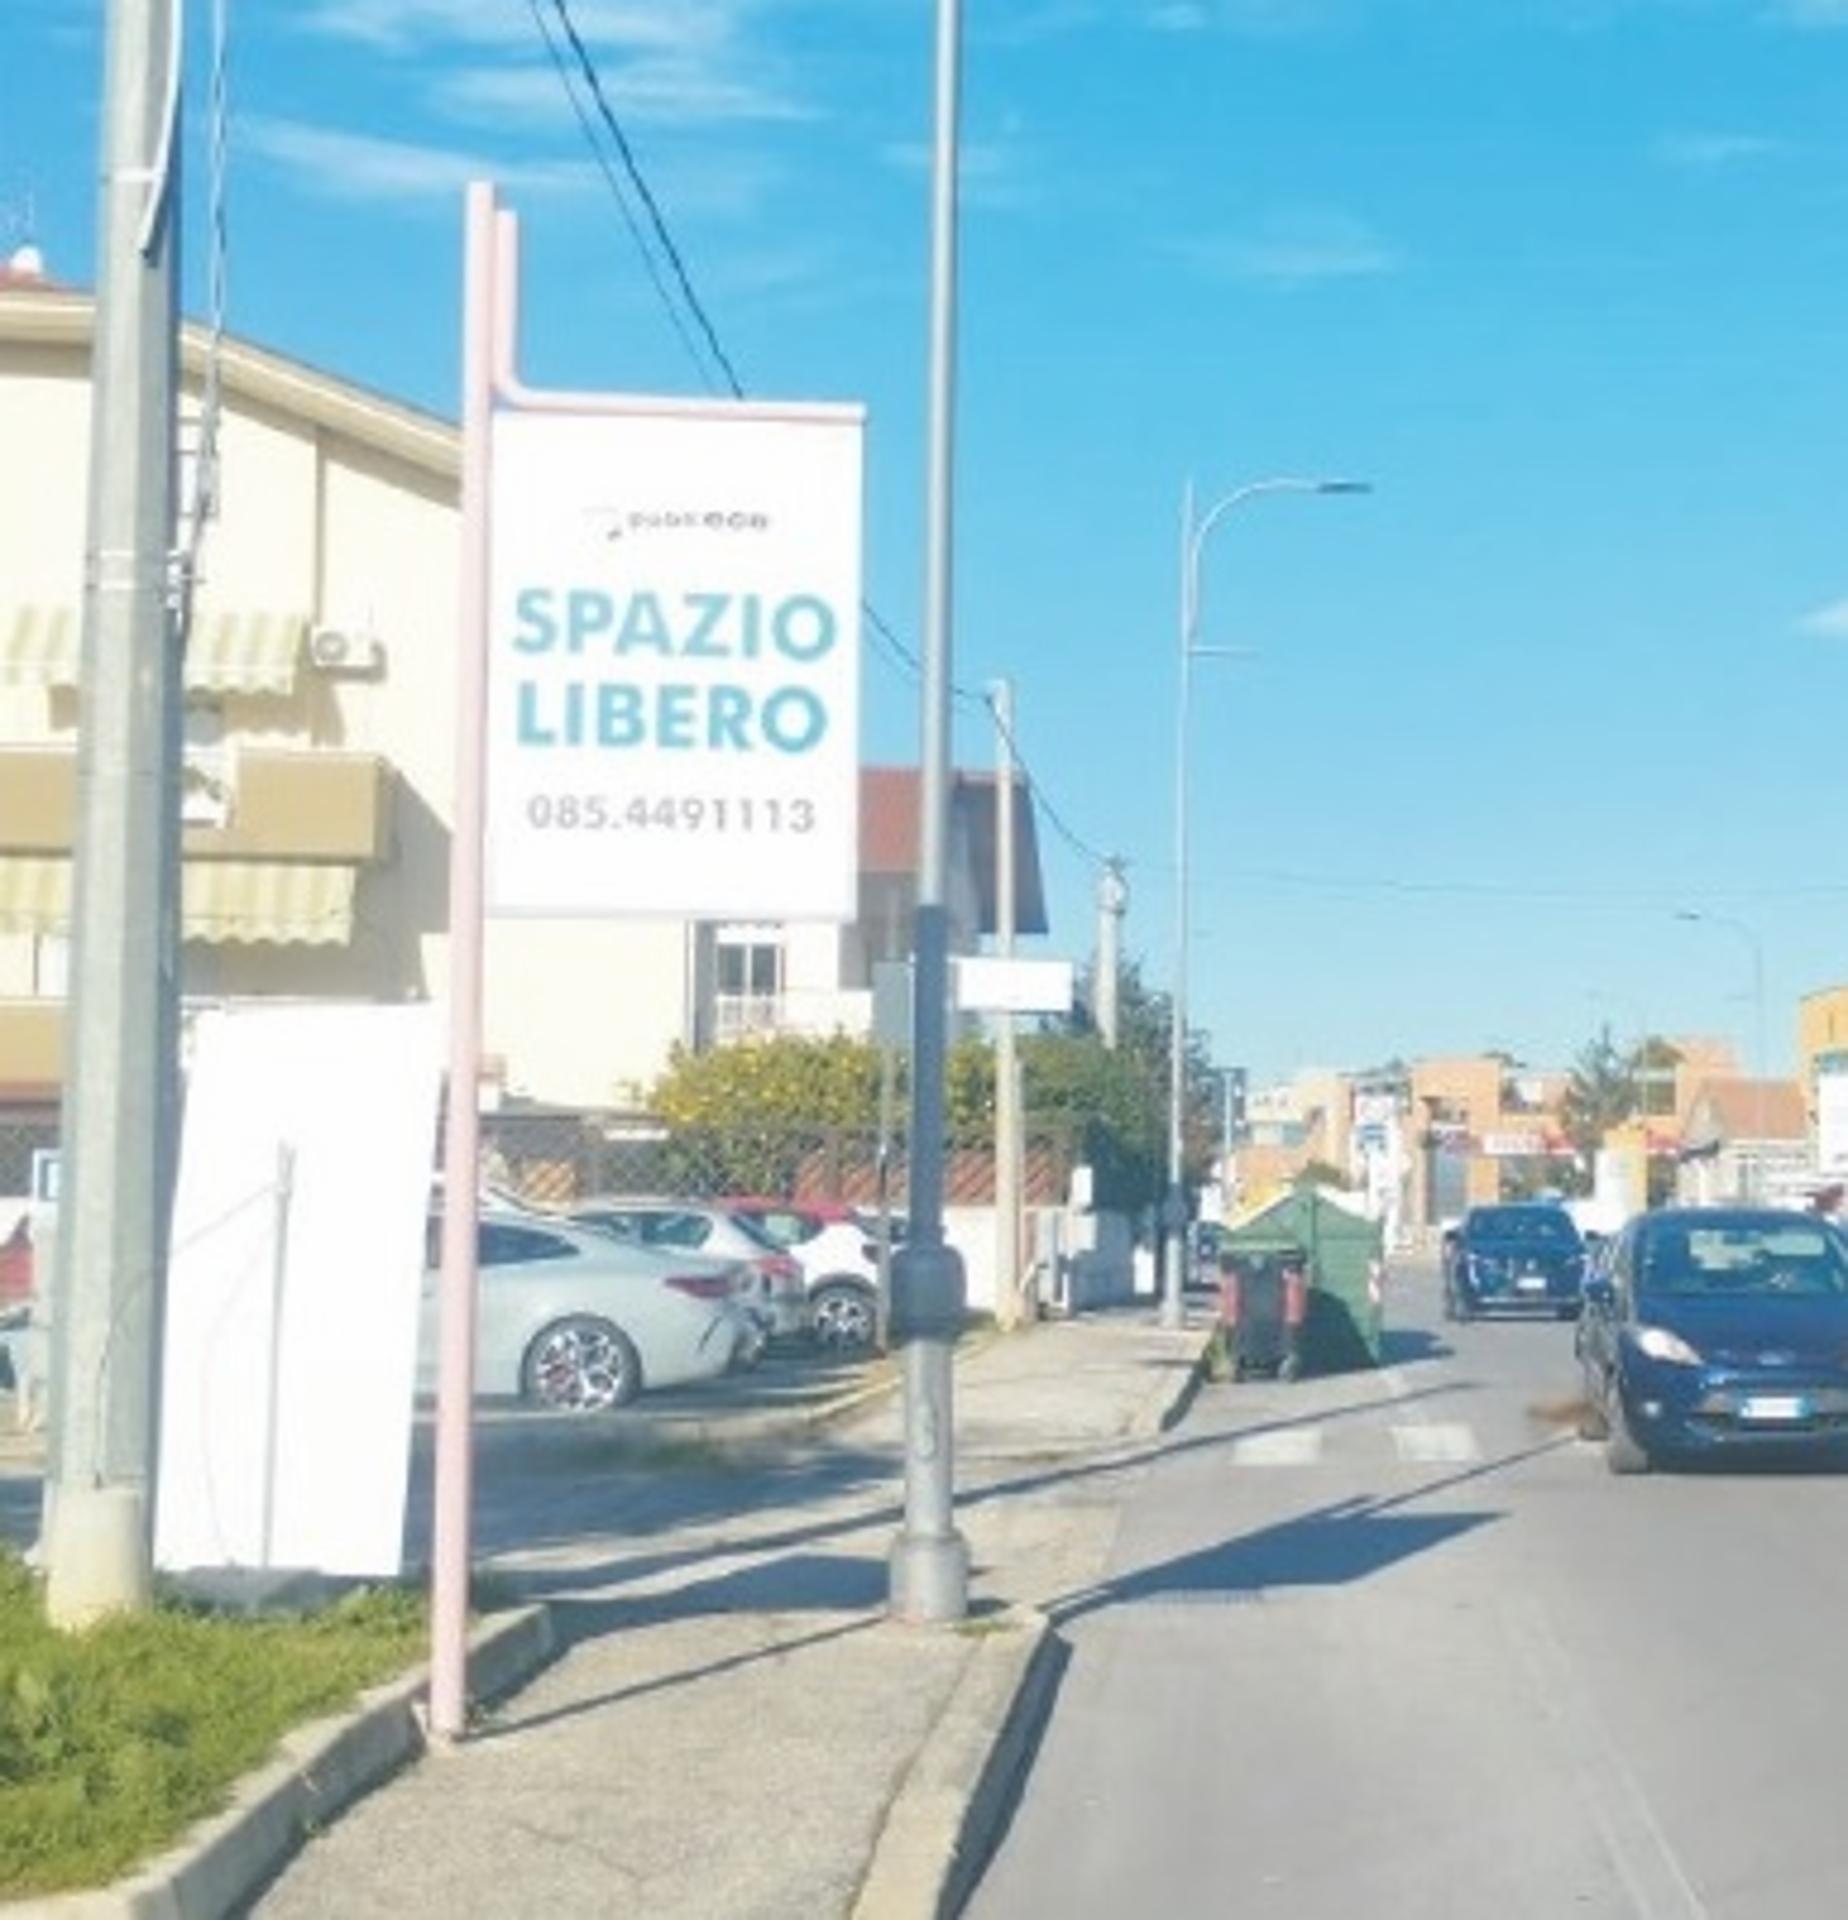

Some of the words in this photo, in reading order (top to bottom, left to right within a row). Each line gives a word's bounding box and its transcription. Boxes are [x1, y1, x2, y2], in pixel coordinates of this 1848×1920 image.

[513, 587, 839, 664] SPAZIO
[516, 680, 830, 756] LIBERO
[527, 795, 815, 833] 085.4491113
